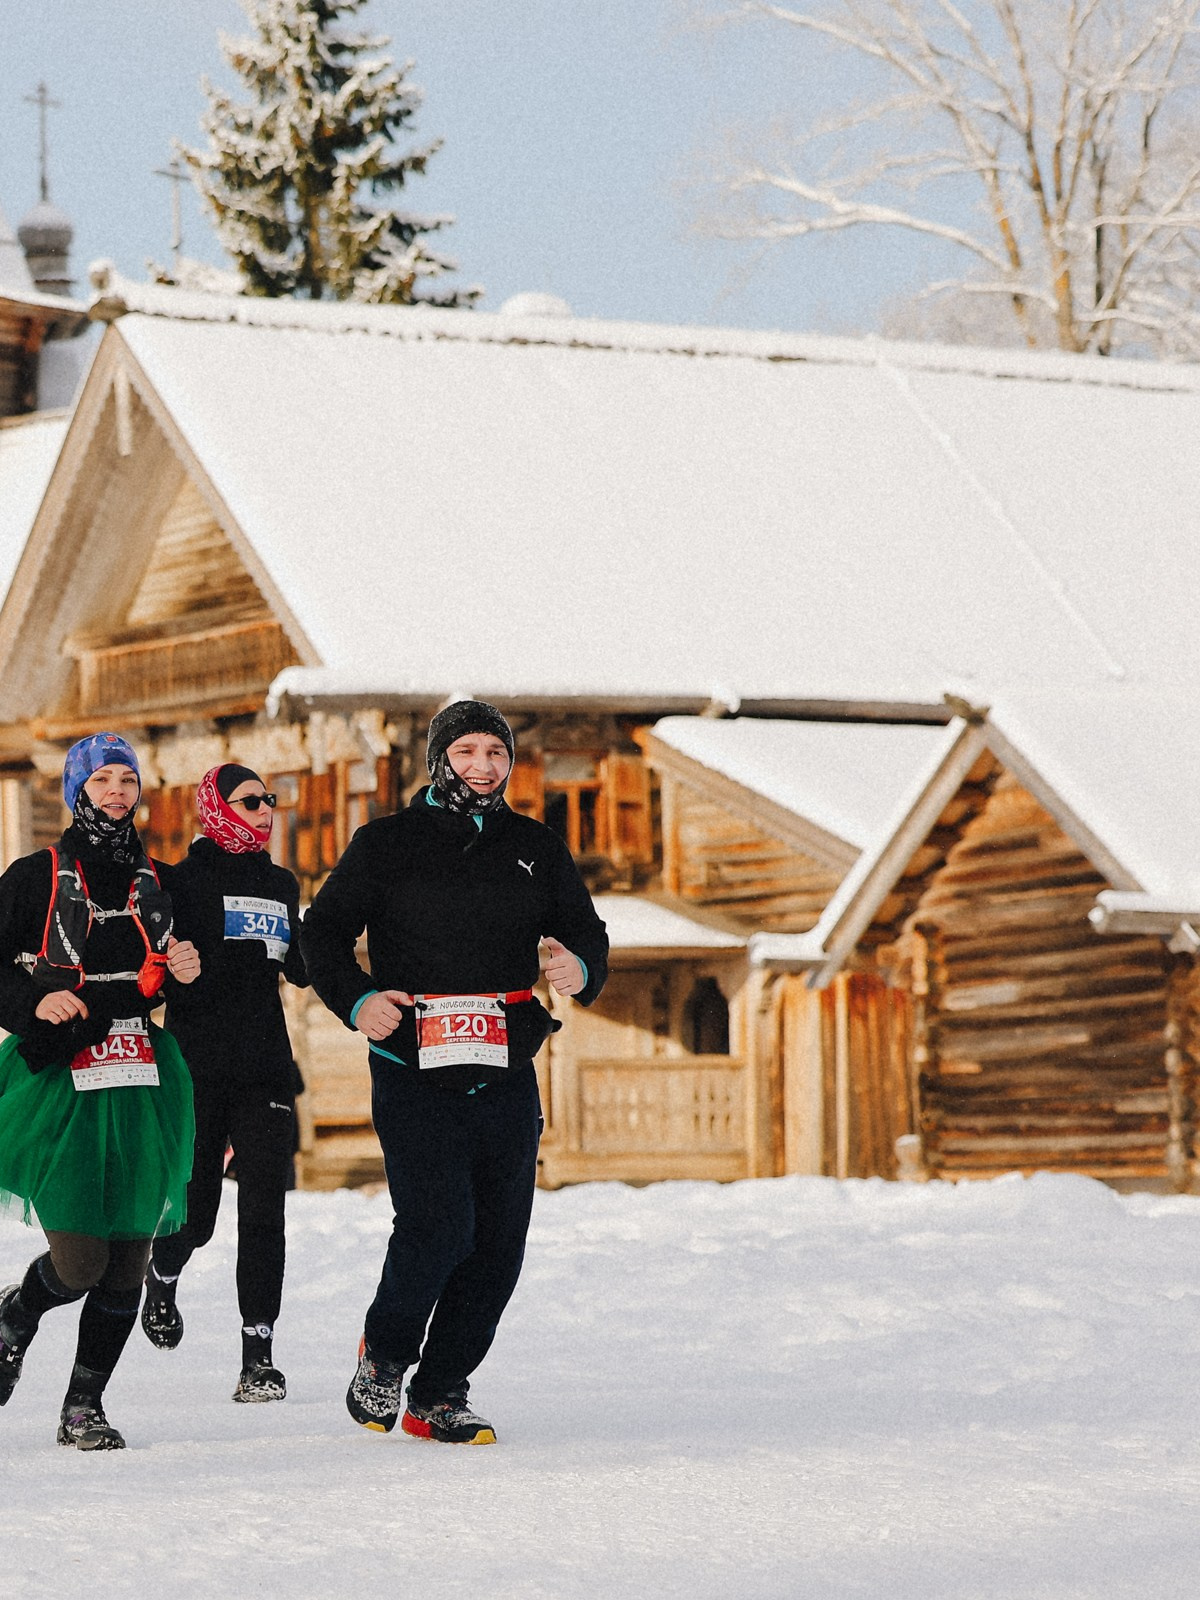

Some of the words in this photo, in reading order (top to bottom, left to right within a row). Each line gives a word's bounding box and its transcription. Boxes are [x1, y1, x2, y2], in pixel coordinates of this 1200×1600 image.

[243, 913, 278, 934] 347
[440, 1000, 475, 1009] NOVGOROD
[440, 1015, 488, 1038] 120
[90, 1036, 139, 1060] 043
